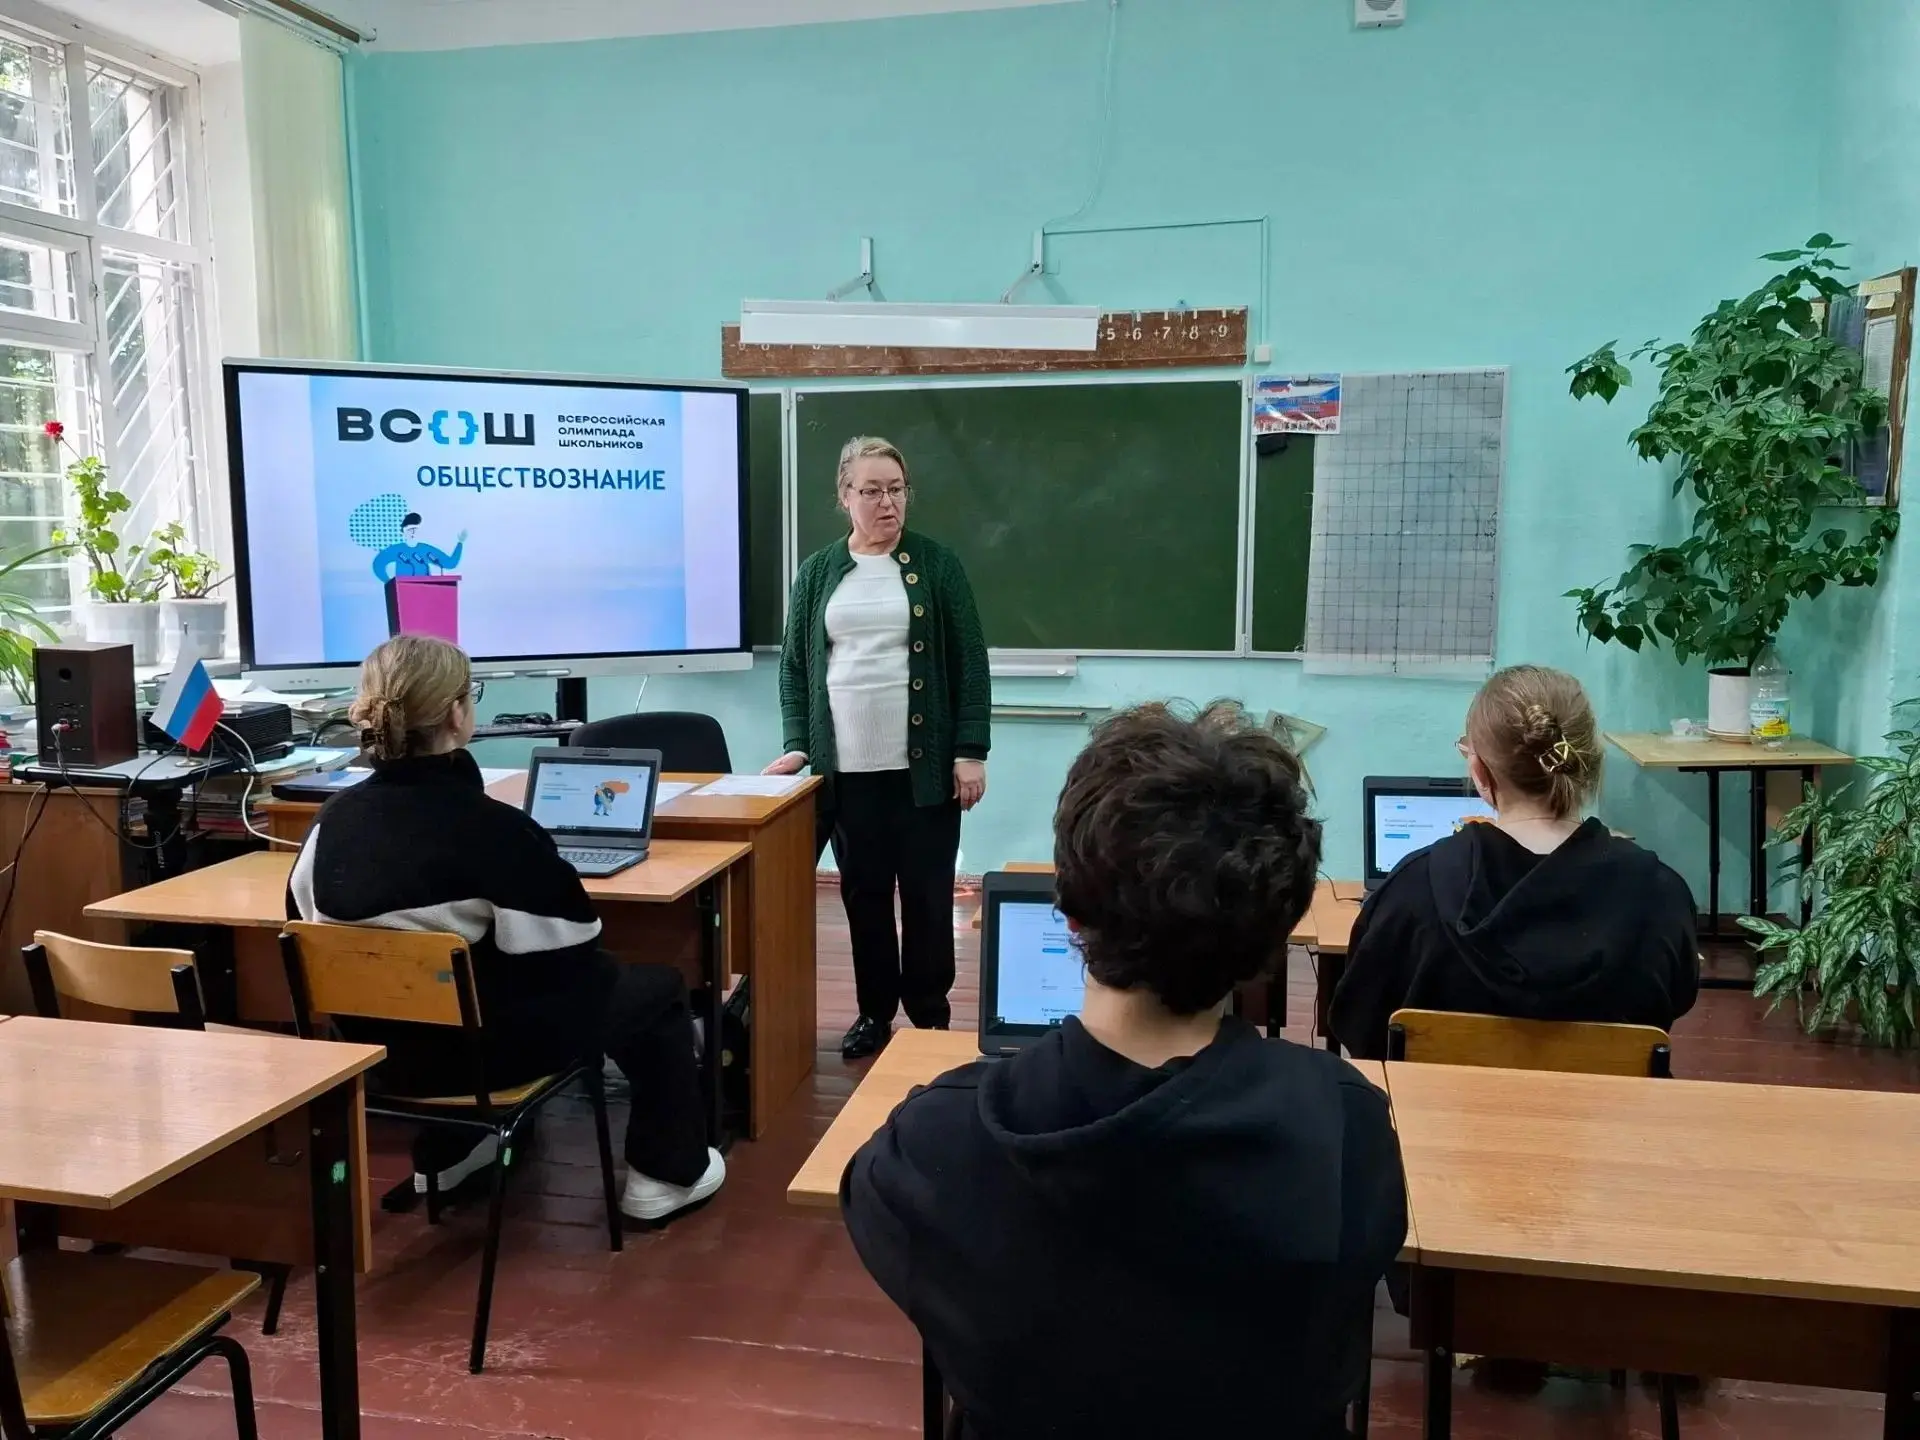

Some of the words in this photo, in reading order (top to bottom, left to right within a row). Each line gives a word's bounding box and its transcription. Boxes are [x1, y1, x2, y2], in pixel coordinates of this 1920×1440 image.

[557, 414, 666, 426] ВСЕРОССИЙСКАЯ
[558, 427, 636, 438] ОЛИМПИАДА
[558, 439, 644, 450] ШКОЛЬНИКОВ
[416, 465, 666, 492] ОБЩЕСТВОЗНАНИЕ
